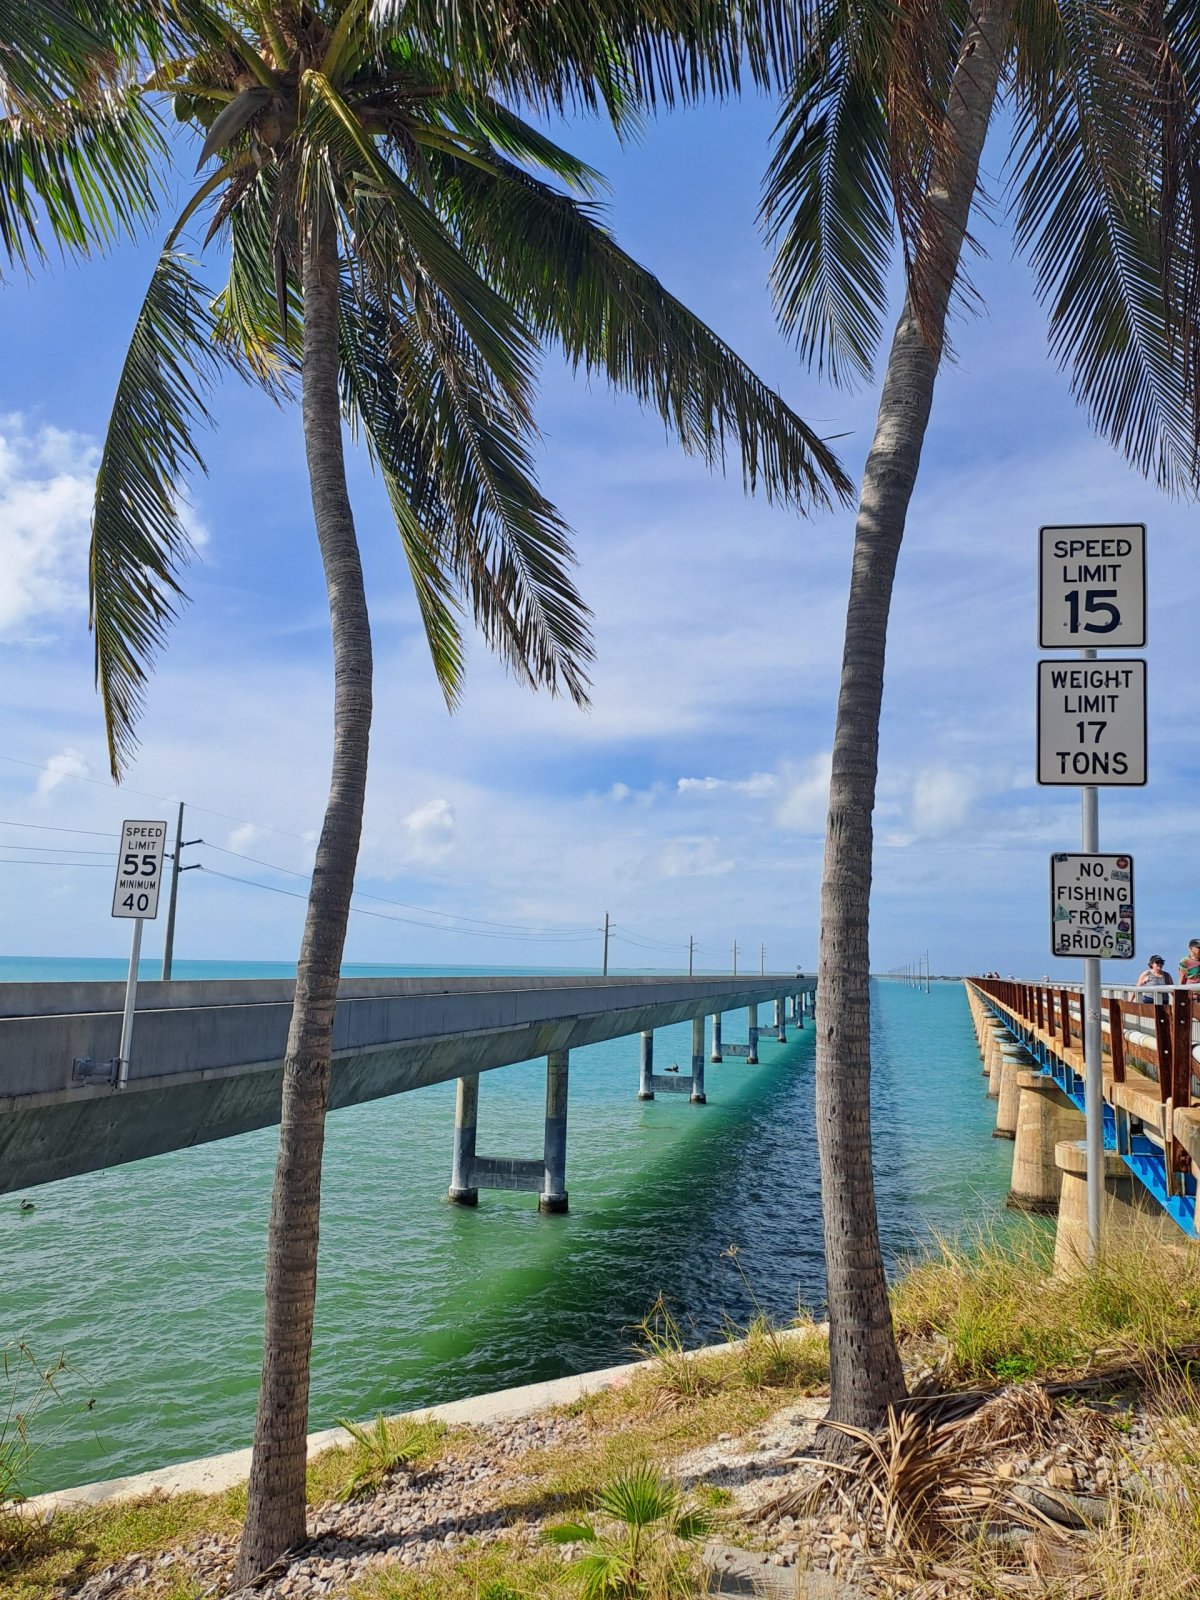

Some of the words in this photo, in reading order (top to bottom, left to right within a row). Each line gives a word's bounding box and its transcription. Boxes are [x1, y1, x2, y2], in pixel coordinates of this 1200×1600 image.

[1053, 539, 1132, 558] SPEED
[1063, 564, 1122, 583] LIMIT
[1064, 589, 1121, 634] 15
[1051, 670, 1133, 689] WEIGHT
[1064, 695, 1119, 713] LIMIT
[1076, 721, 1107, 744] 17
[1056, 752, 1128, 775] TONS
[126, 827, 163, 837] SPEED
[128, 841, 157, 851] LIMIT
[122, 854, 157, 877] 55
[1080, 862, 1104, 877] NO
[119, 880, 156, 890] MINIMUM
[1057, 886, 1128, 902] FISHING
[122, 893, 149, 912] 40
[1068, 910, 1117, 925] FROM
[1060, 934, 1119, 949] BRIDG
